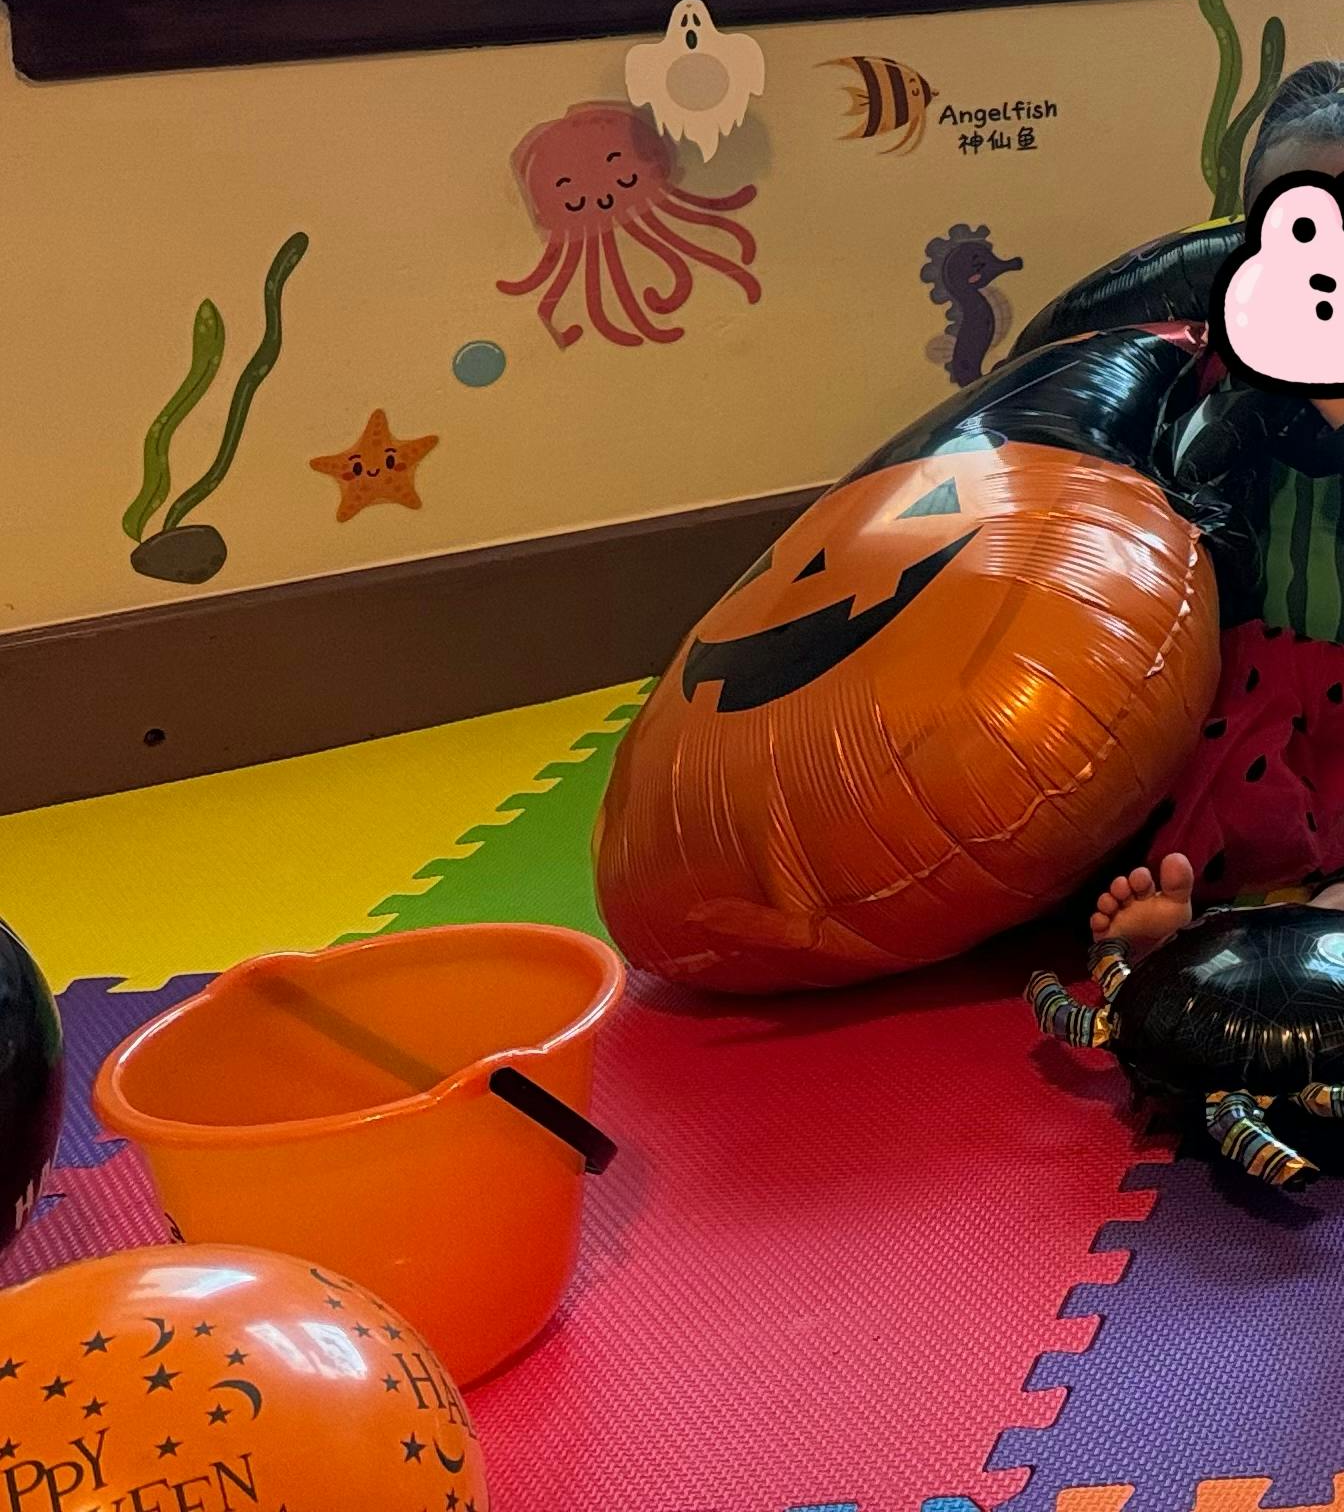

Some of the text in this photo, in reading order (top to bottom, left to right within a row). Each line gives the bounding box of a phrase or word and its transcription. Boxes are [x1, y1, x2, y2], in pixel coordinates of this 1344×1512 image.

[938, 99, 1058, 129] Angelfish
[957, 125, 1039, 156] 神仙鱼
